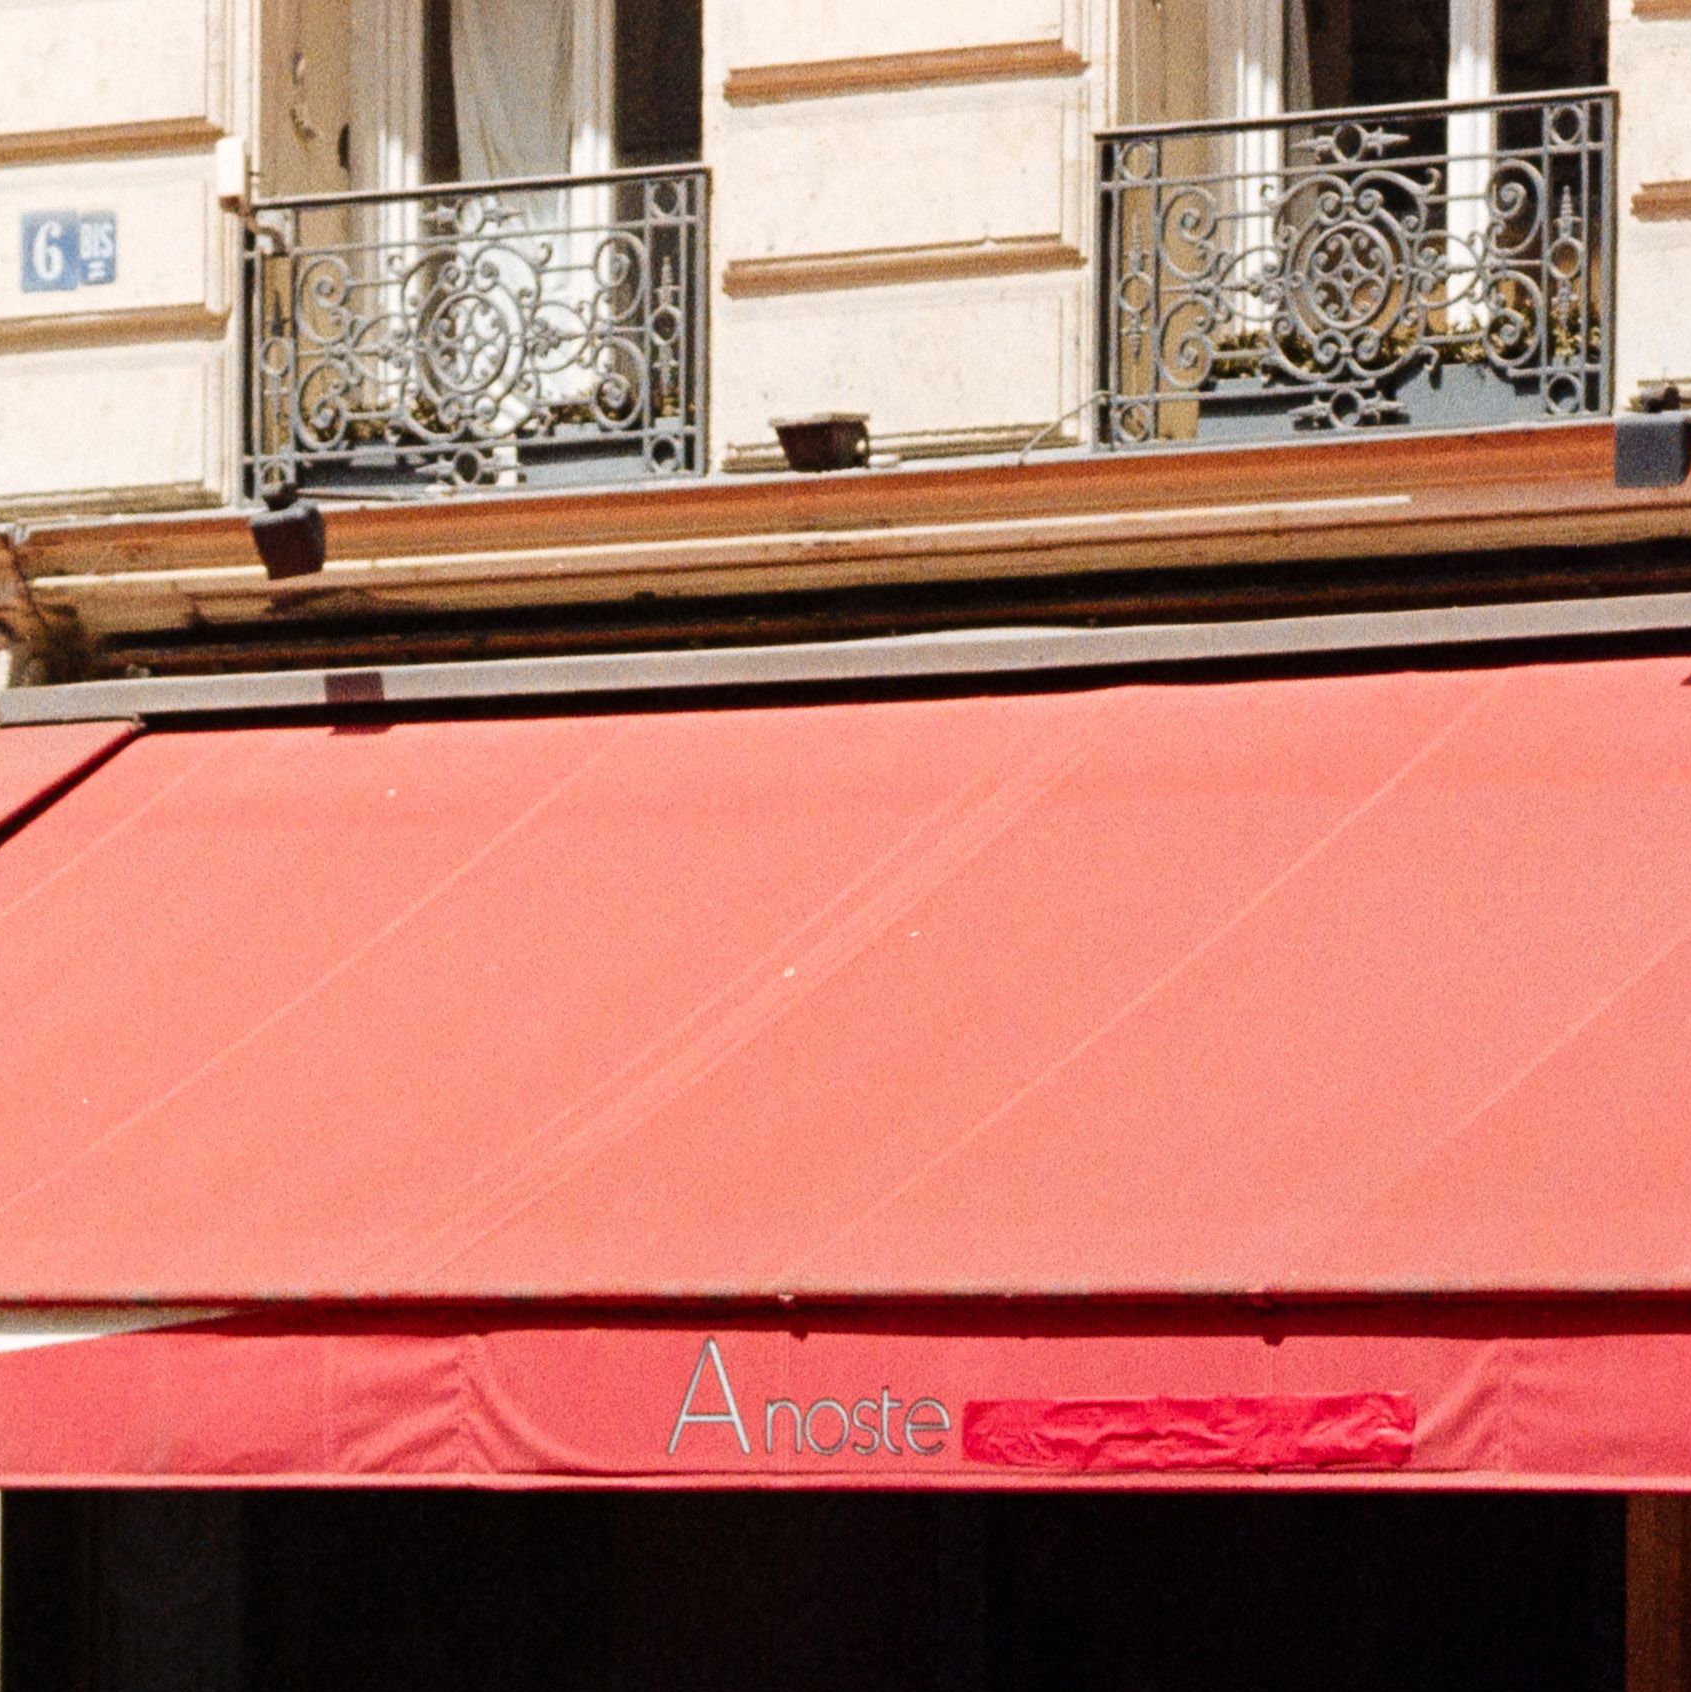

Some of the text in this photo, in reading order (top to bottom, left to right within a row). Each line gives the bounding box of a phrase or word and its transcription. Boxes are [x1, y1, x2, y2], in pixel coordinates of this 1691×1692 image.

[32, 220, 65, 281] 6
[667, 1335, 951, 1456] A noste
